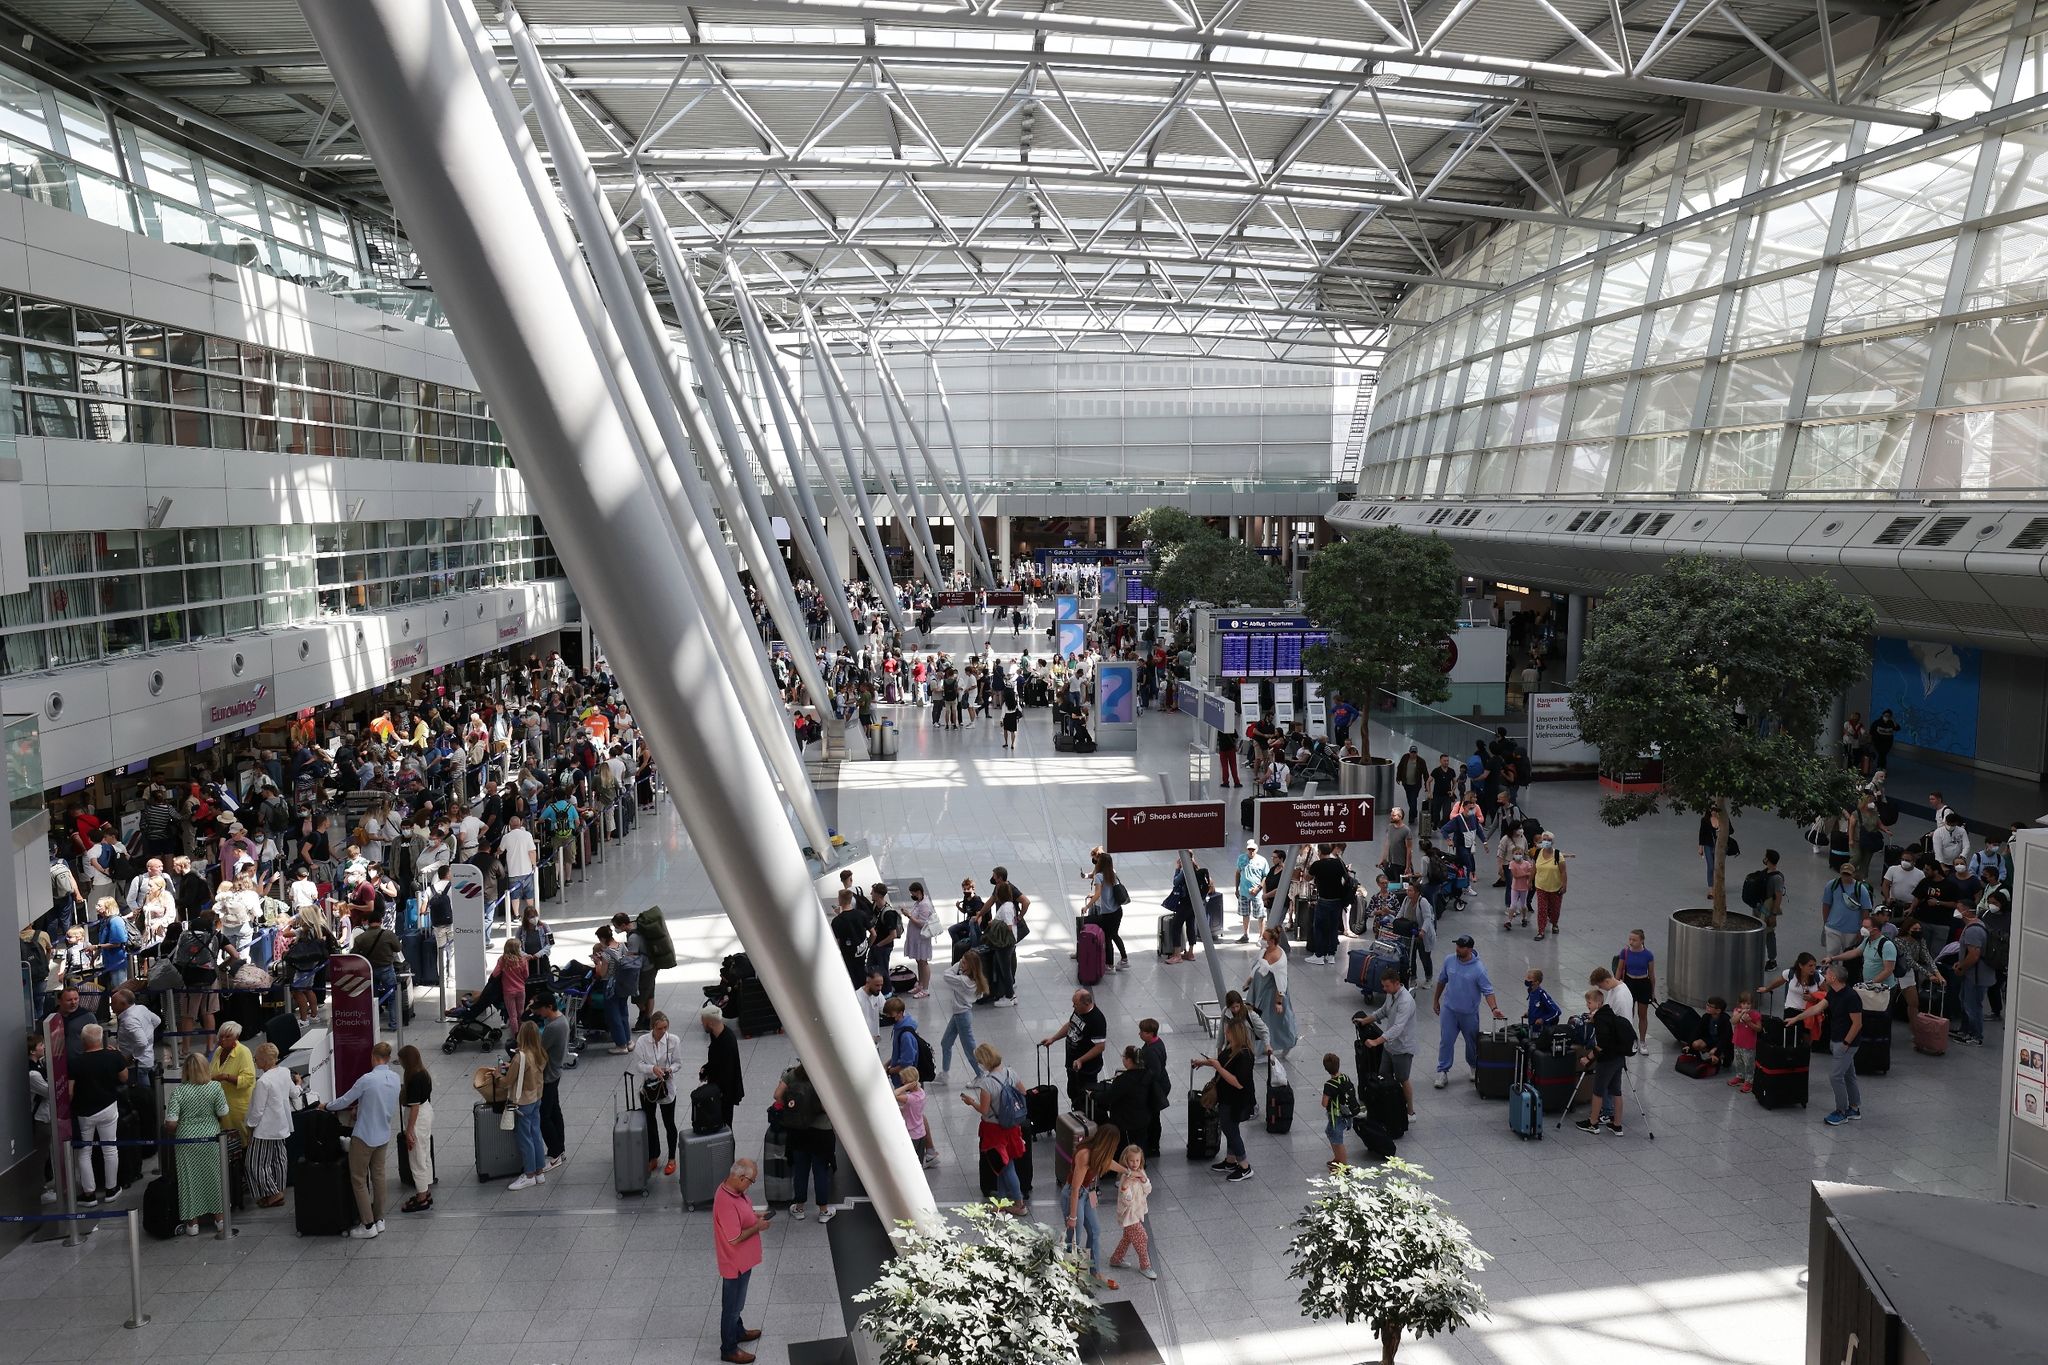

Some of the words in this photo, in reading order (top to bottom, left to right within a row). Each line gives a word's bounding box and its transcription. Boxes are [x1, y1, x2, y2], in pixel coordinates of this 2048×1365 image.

[211, 699, 256, 721] Eurowings
[1296, 820, 1334, 828] Wickelraum
[1300, 828, 1316, 836] Baby
[335, 1010, 365, 1018] Priority-
